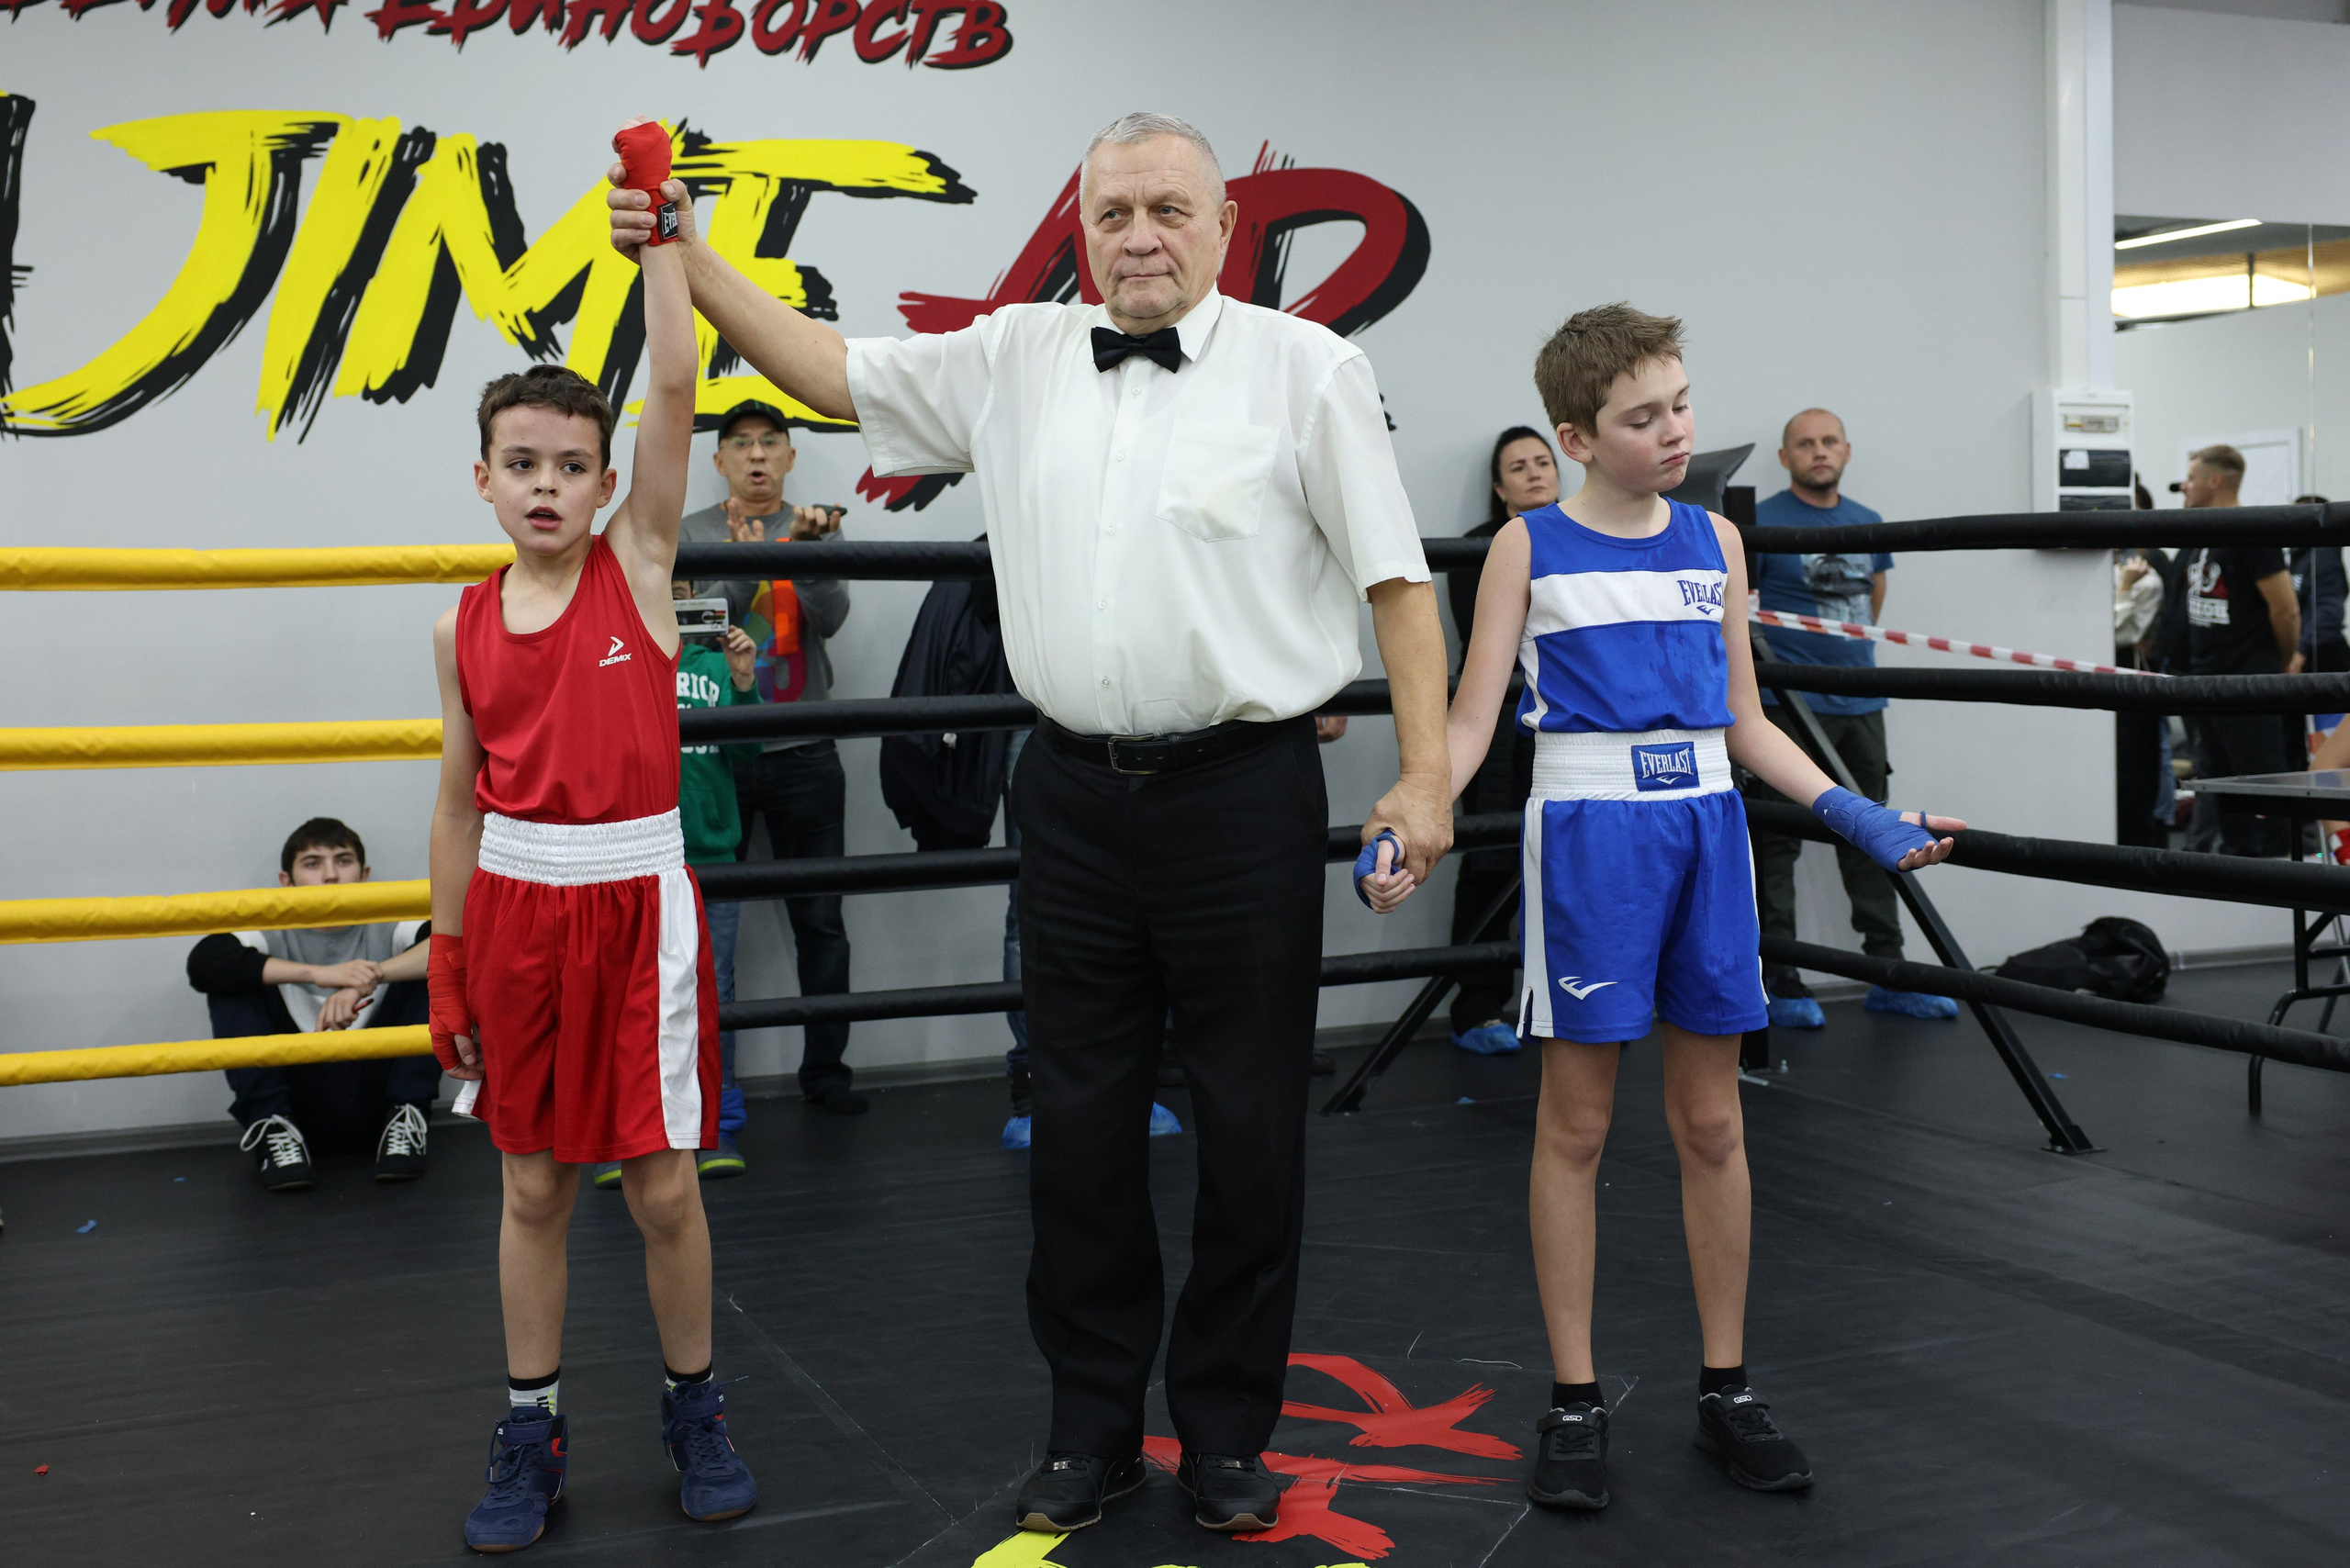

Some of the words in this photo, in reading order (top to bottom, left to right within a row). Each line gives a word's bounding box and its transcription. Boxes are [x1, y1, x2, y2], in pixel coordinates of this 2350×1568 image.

[0, 90, 978, 446] JIME
[1677, 579, 1724, 608] EVELAS
[599, 652, 632, 667] DEMIX
[1639, 746, 1692, 779] EVERLAST
[1733, 1394, 1752, 1404] GSD
